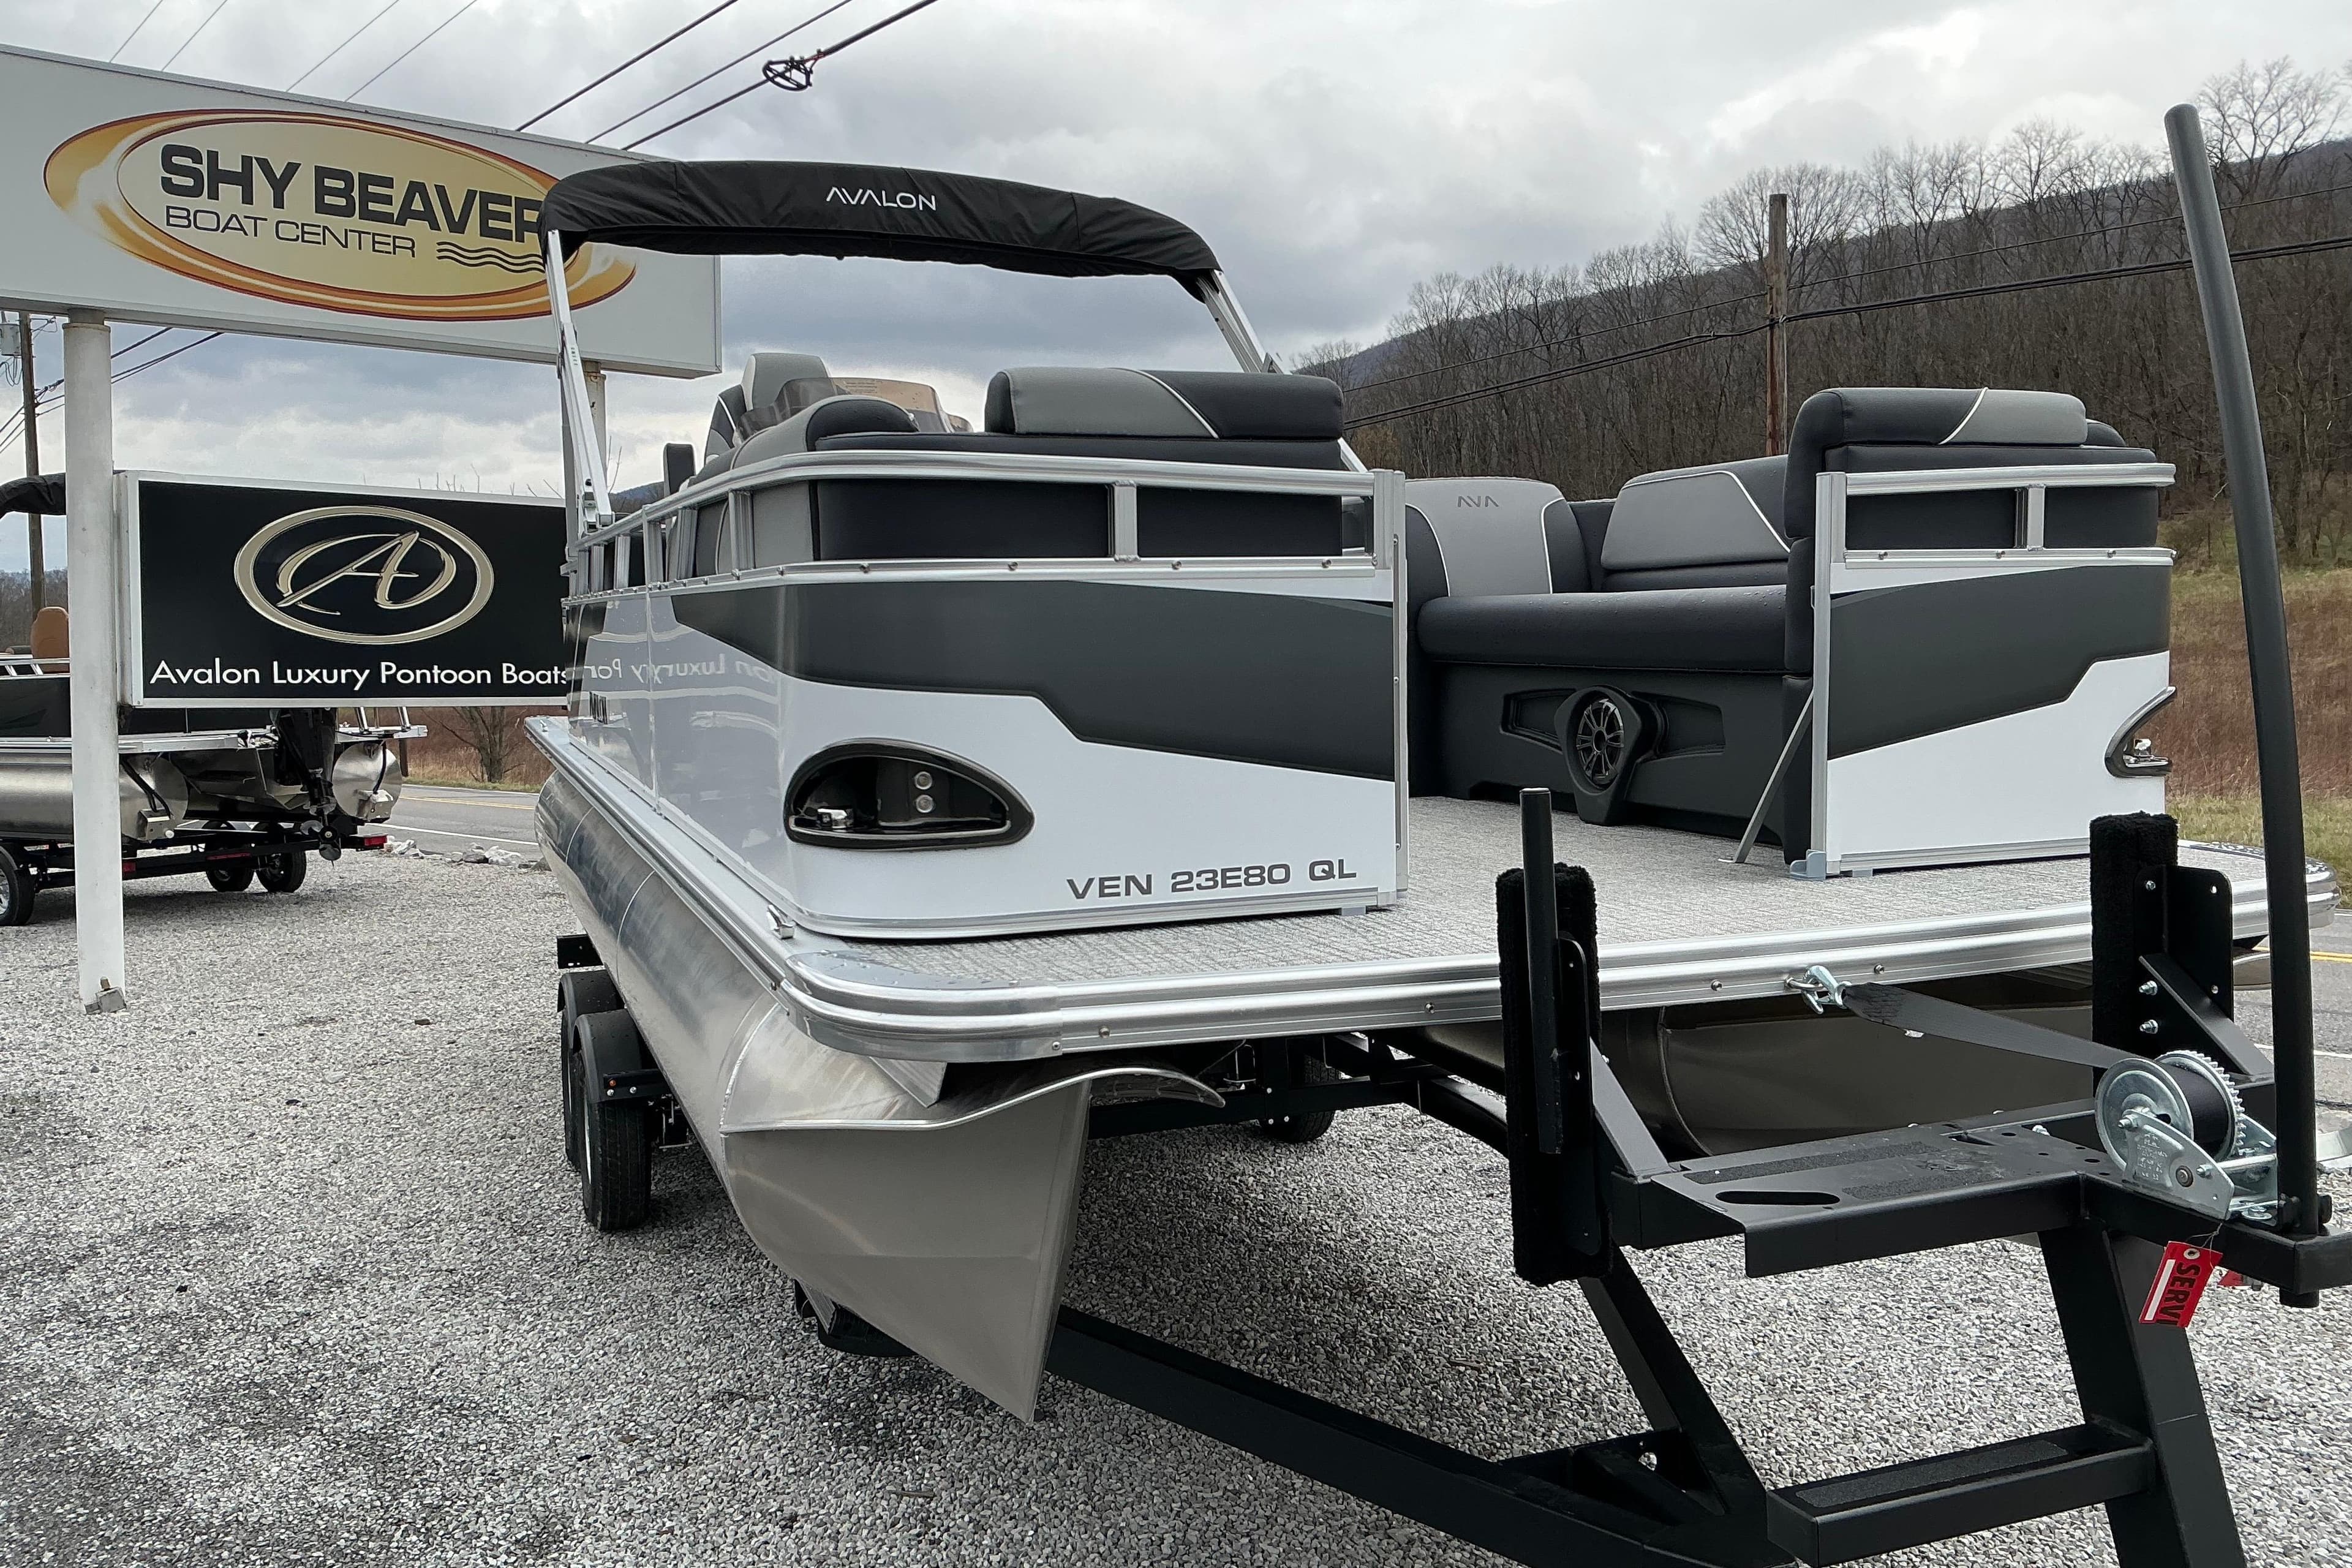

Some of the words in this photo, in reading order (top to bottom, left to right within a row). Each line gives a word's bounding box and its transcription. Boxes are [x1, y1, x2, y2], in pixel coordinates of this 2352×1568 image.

[160, 144, 301, 209] SHY
[826, 186, 937, 211] AVALON
[165, 205, 268, 237] BOAT
[275, 219, 416, 258] CENTER
[149, 657, 260, 685] Avalon
[273, 662, 371, 691] Luxury
[380, 662, 491, 684] Pontoon
[1066, 874, 1152, 899] VEN
[1170, 864, 1291, 893] 23E80
[1309, 859, 1357, 882] QL
